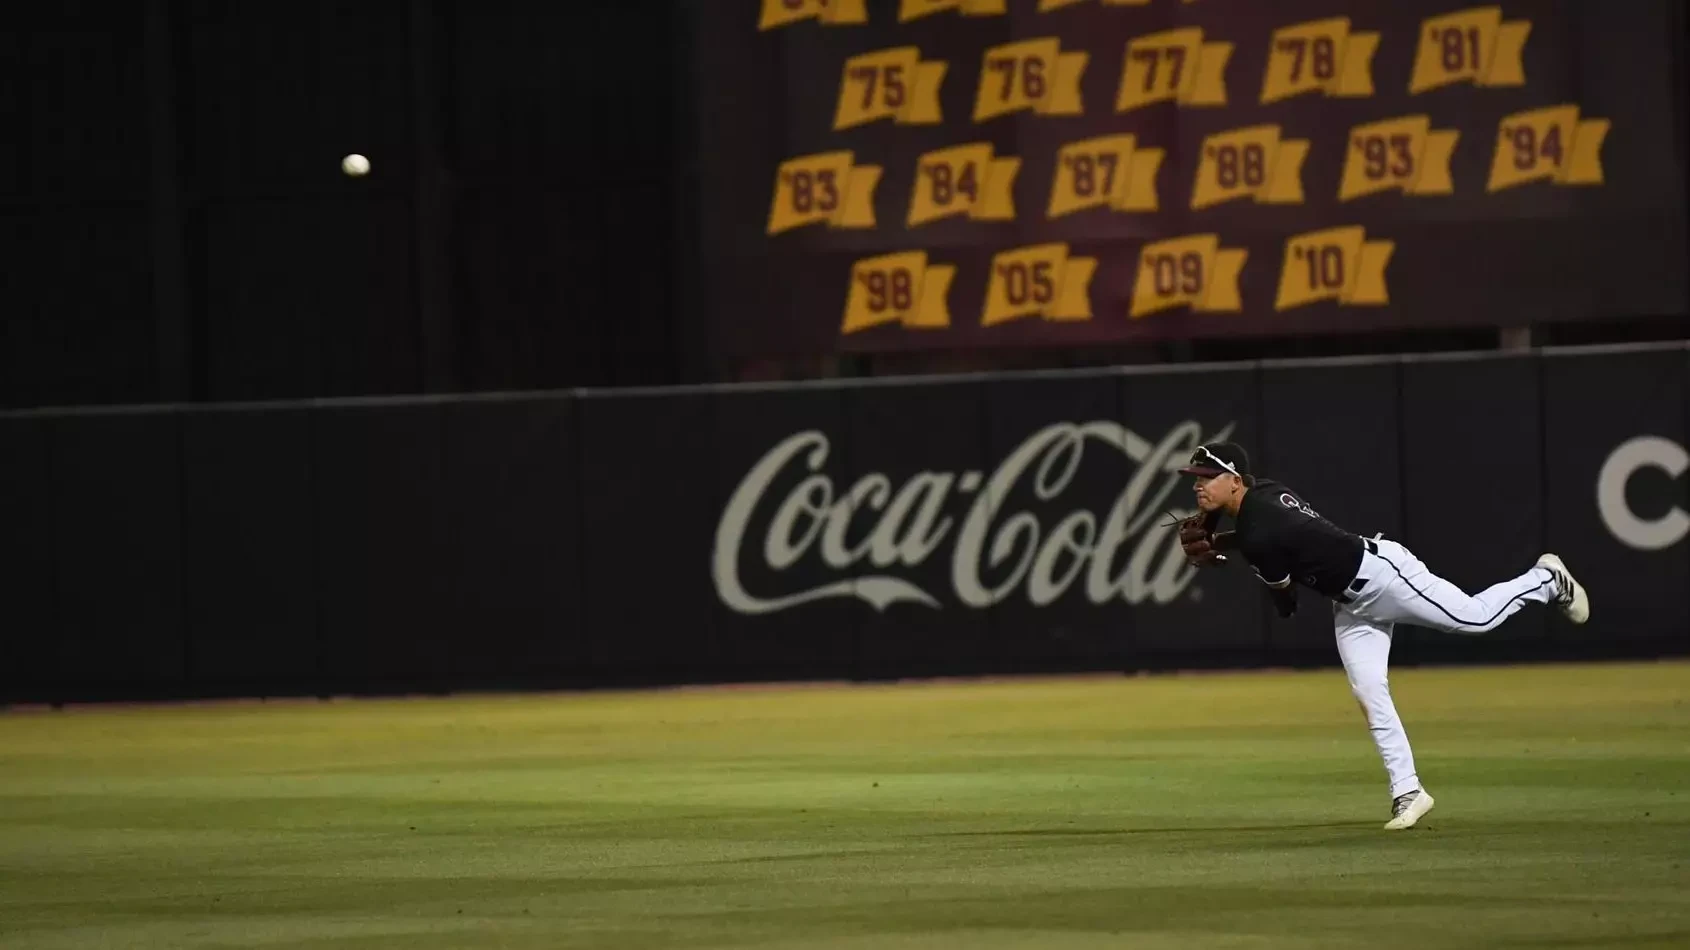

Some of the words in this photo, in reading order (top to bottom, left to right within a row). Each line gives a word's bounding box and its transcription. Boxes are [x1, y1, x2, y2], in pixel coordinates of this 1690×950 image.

[849, 66, 907, 109] '75
[987, 55, 1046, 101] '76
[1131, 46, 1188, 92] '77
[1276, 36, 1336, 83] '78
[1430, 26, 1480, 72] '81
[781, 168, 838, 214] '83
[923, 161, 978, 205] '84
[1064, 153, 1120, 197] '87
[1207, 144, 1265, 188] '88
[1354, 134, 1413, 181] '93
[1505, 126, 1563, 171] '94
[858, 268, 912, 313] '98
[997, 262, 1053, 307] '05
[1145, 253, 1203, 297] '09
[1295, 244, 1345, 290] '10
[711, 420, 1236, 615] Coca-Cola
